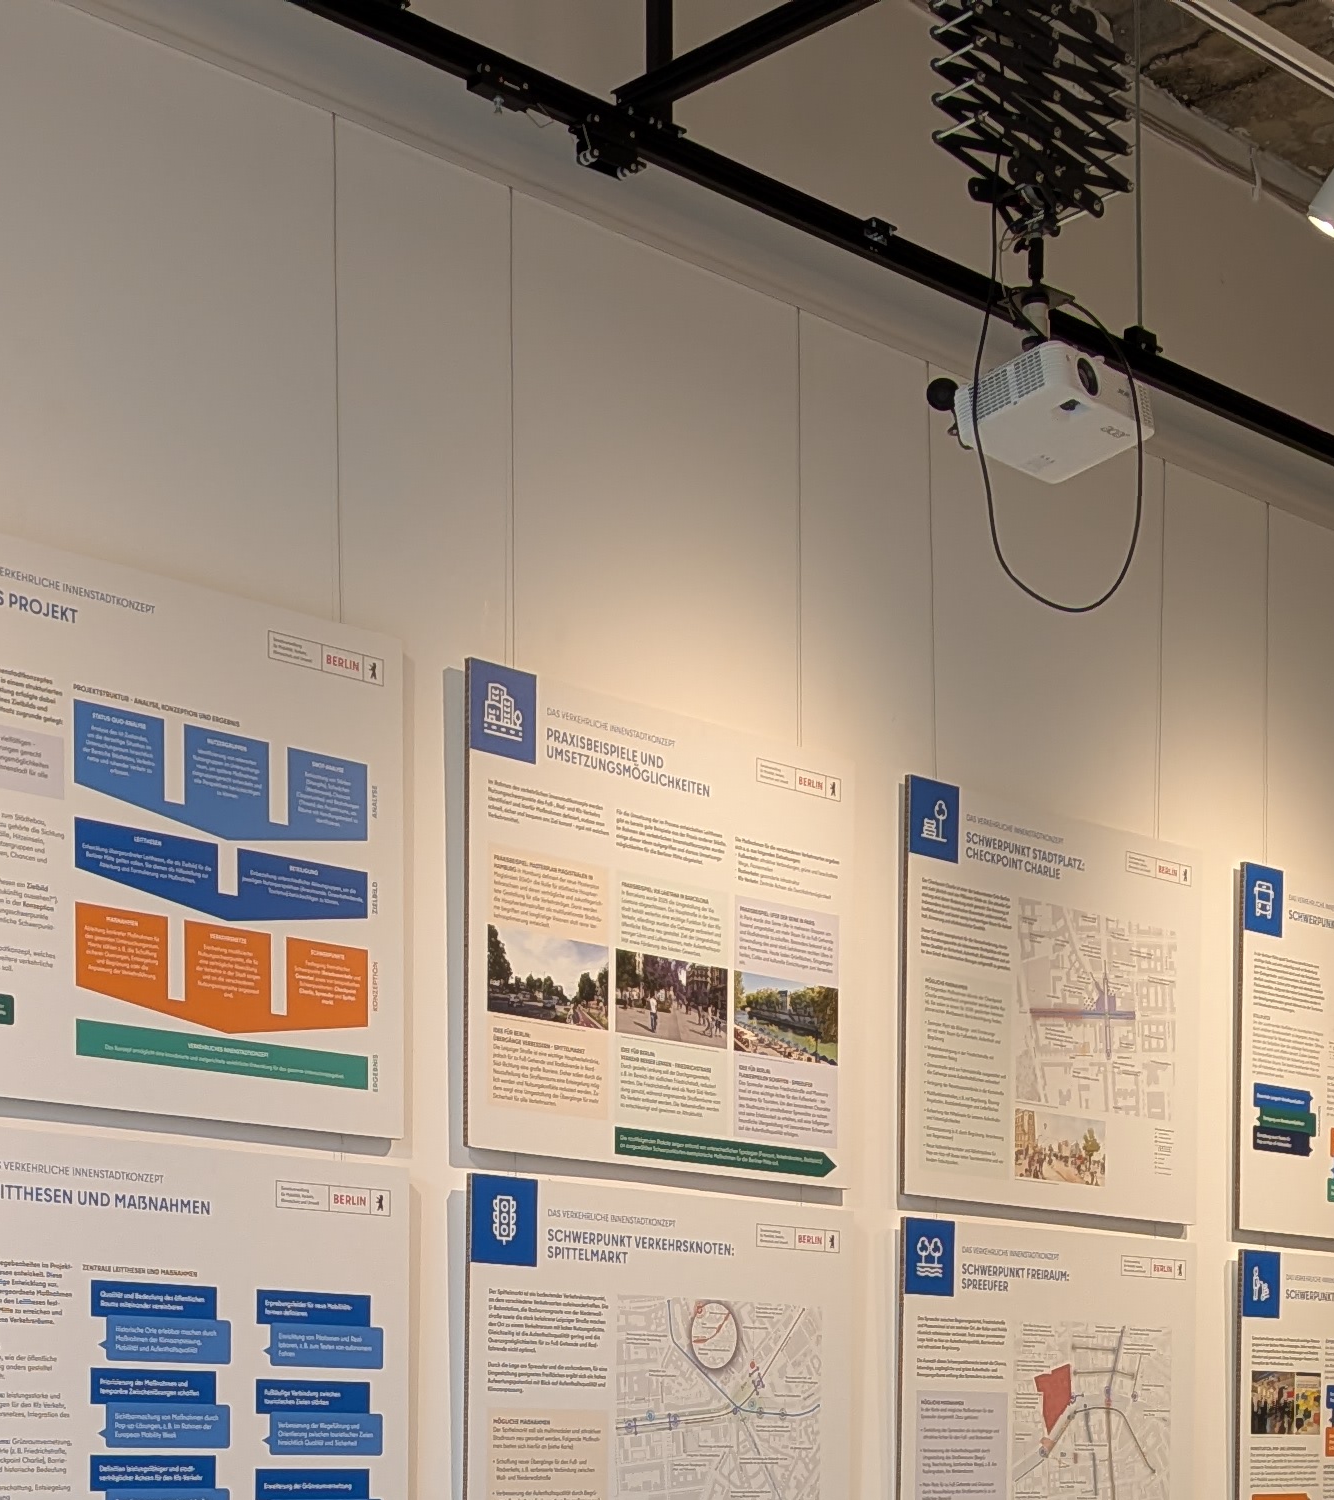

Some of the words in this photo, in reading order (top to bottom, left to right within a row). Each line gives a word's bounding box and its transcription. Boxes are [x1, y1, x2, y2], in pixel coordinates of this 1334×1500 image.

[9, 593, 78, 623] PROJEKT
[62, 583, 155, 614] INNENSTADTKONZEPT
[326, 654, 359, 671] BERLIN
[546, 727, 637, 762] PRAXISBEISPIELE
[640, 751, 663, 768] UND
[546, 744, 709, 797] UMSETZUNGSMÖGLICHKEITEN
[798, 776, 823, 790] BERLIN
[966, 831, 1031, 857] SCHWERPUNKT
[1032, 847, 1084, 870] STADTPLATZ:
[965, 846, 1023, 870] CHECKPOINT
[1024, 860, 1060, 879] CHARLIE
[3, 1161, 69, 1175] VERKEHRLICHE
[72, 1167, 163, 1183] INNENSTADTKONZEPT
[77, 1190, 110, 1206] UND
[114, 1193, 210, 1215] MAßNAHMEN
[333, 1193, 366, 1206] BERLIN
[547, 1208, 561, 1217] DAS
[561, 1210, 608, 1222] VERKEHRLICHE
[610, 1214, 675, 1227] INNENSTADTKONZEPT
[547, 1228, 632, 1247] SCHWERPUNKT
[634, 1236, 734, 1256] VERKEHRSKNOTEN:
[797, 1234, 822, 1244] BERLIN
[547, 1245, 628, 1263] SPITTELMARKT
[961, 1263, 1025, 1278] SCHWERPUNKT
[1026, 1267, 1069, 1281] FREIRAUM:
[961, 1277, 1008, 1291] SPREEUFER
